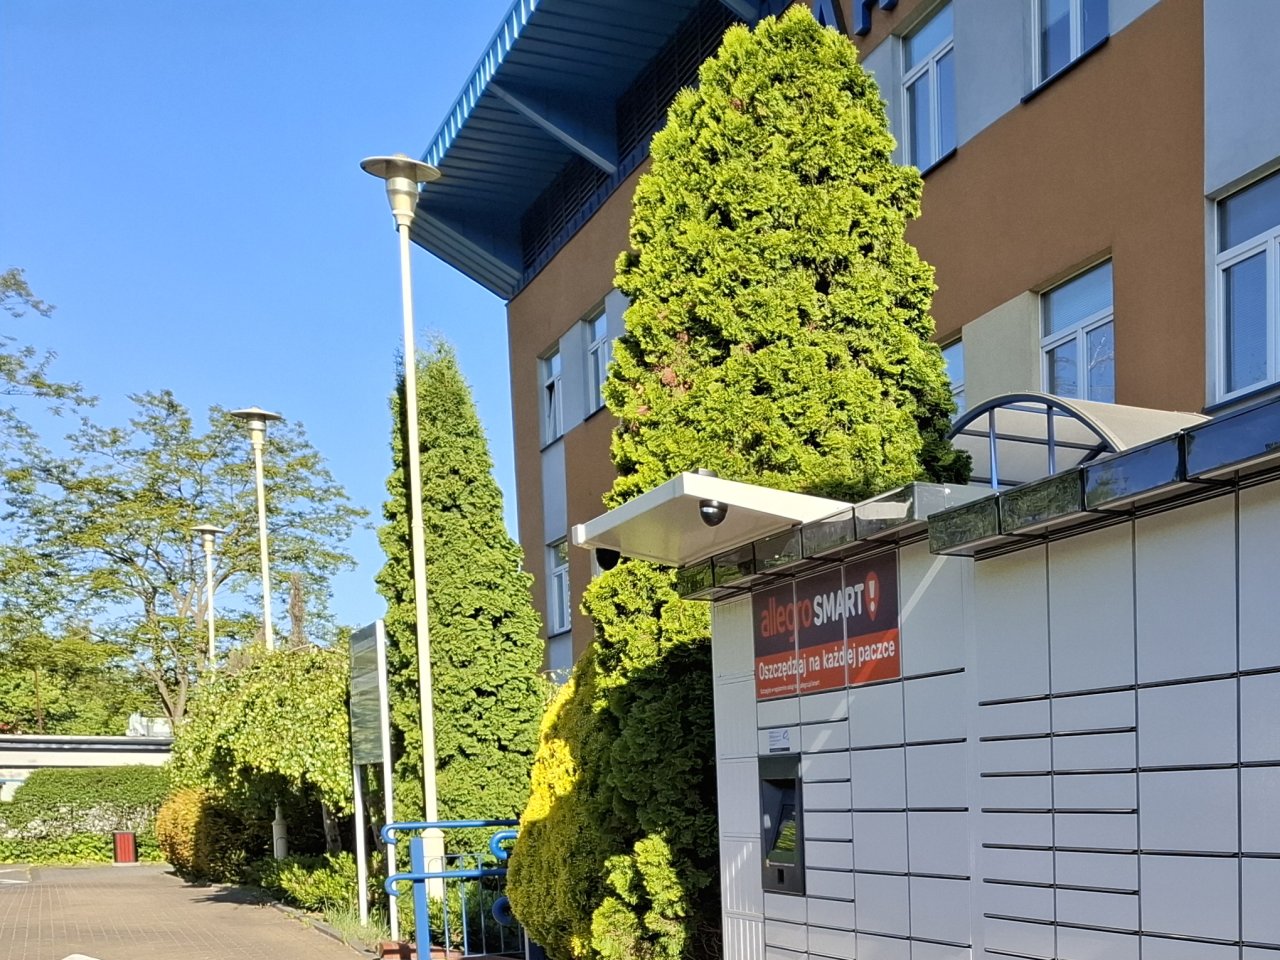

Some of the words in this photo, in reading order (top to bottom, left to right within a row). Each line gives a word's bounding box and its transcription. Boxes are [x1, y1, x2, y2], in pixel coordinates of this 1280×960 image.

[760, 596, 812, 642] allegro
[758, 653, 806, 681] Oszczędzaj
[809, 656, 820, 672] na
[822, 643, 856, 669] każdej
[858, 640, 895, 667] paczce
